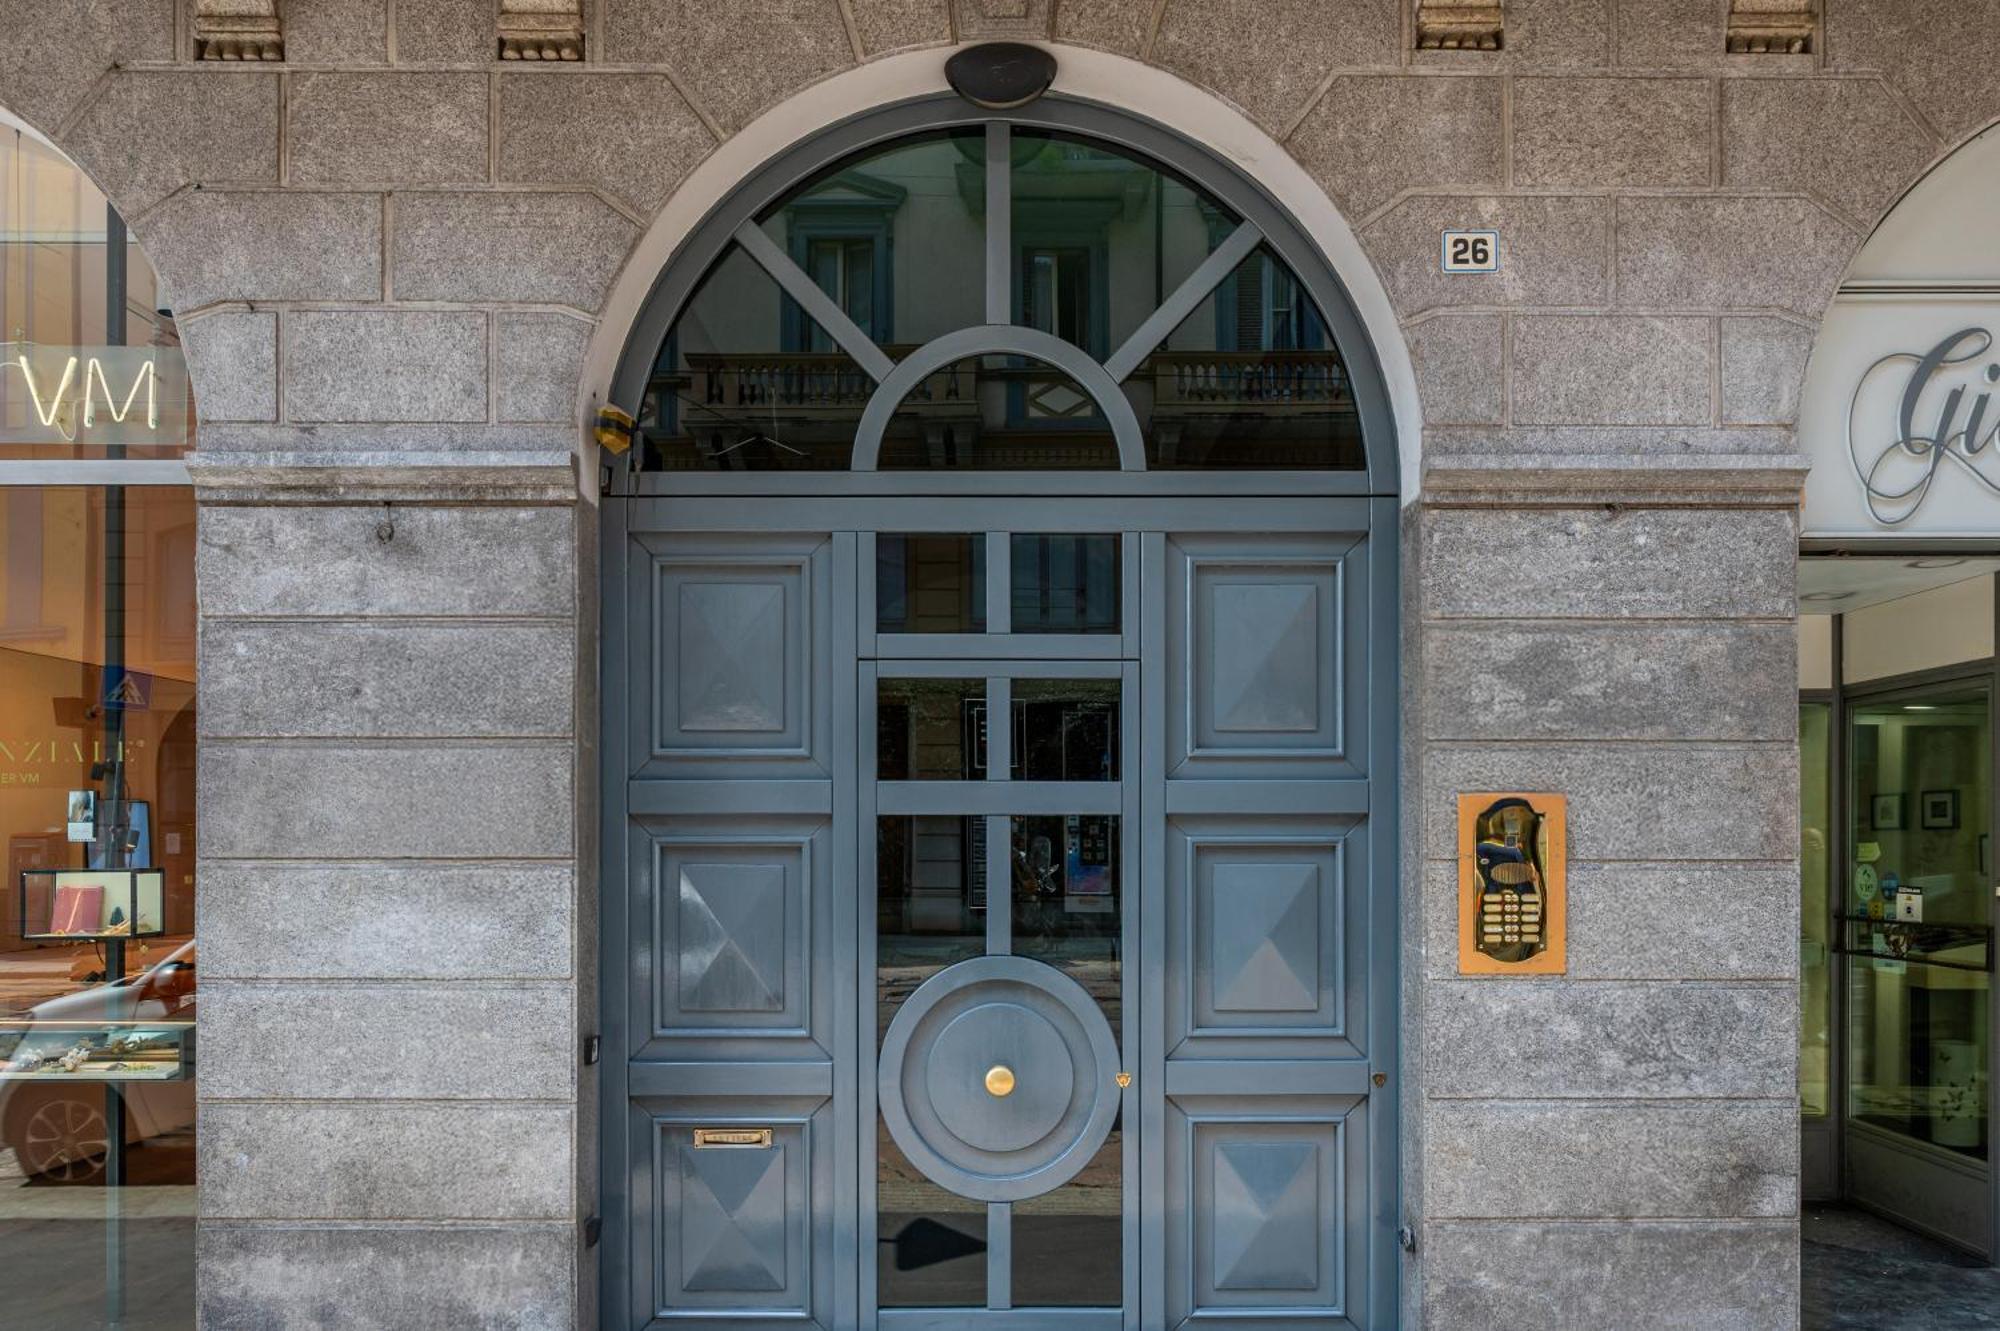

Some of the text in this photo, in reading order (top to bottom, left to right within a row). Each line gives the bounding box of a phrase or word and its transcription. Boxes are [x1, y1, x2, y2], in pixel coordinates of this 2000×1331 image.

[1452, 238, 1489, 265] 26
[19, 355, 157, 430] VM
[1849, 327, 2000, 524] Gi
[21, 773, 40, 784] VM
